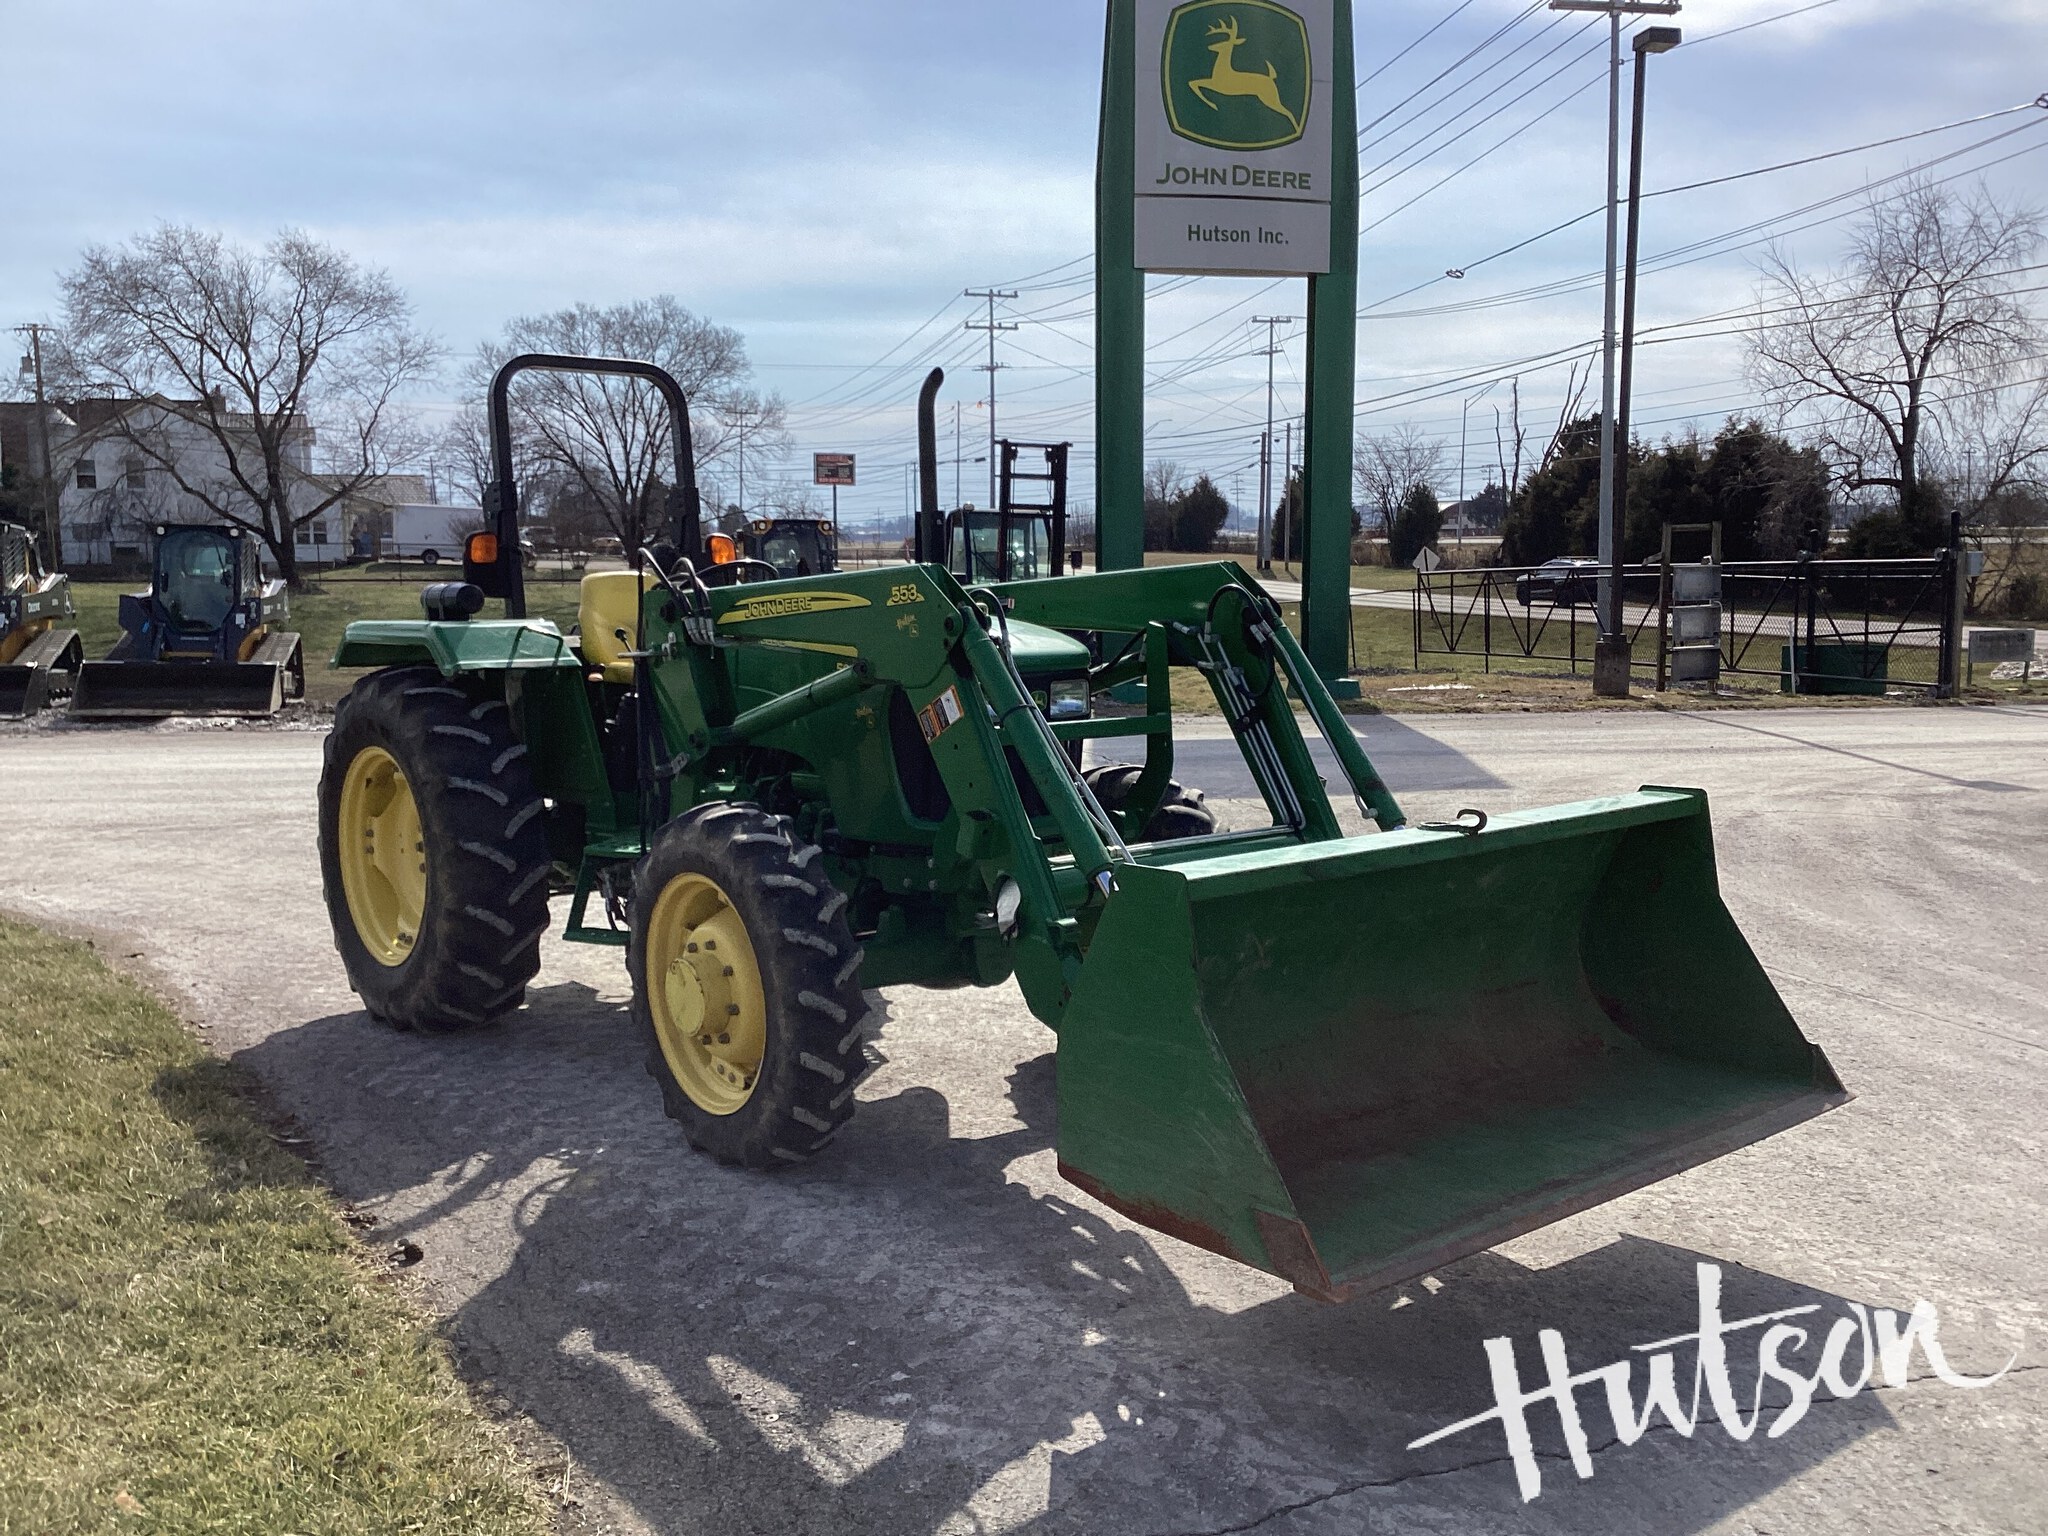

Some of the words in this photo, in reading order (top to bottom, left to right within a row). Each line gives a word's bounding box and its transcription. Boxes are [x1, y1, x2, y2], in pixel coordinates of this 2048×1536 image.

[1156, 163, 1227, 186] JOHN
[1232, 164, 1312, 190] DEERE
[1187, 224, 1250, 243] Hutson
[1258, 227, 1289, 245] Inc.
[891, 583, 918, 602] 553
[745, 602, 775, 618] JOHN
[775, 597, 812, 613] DEERE
